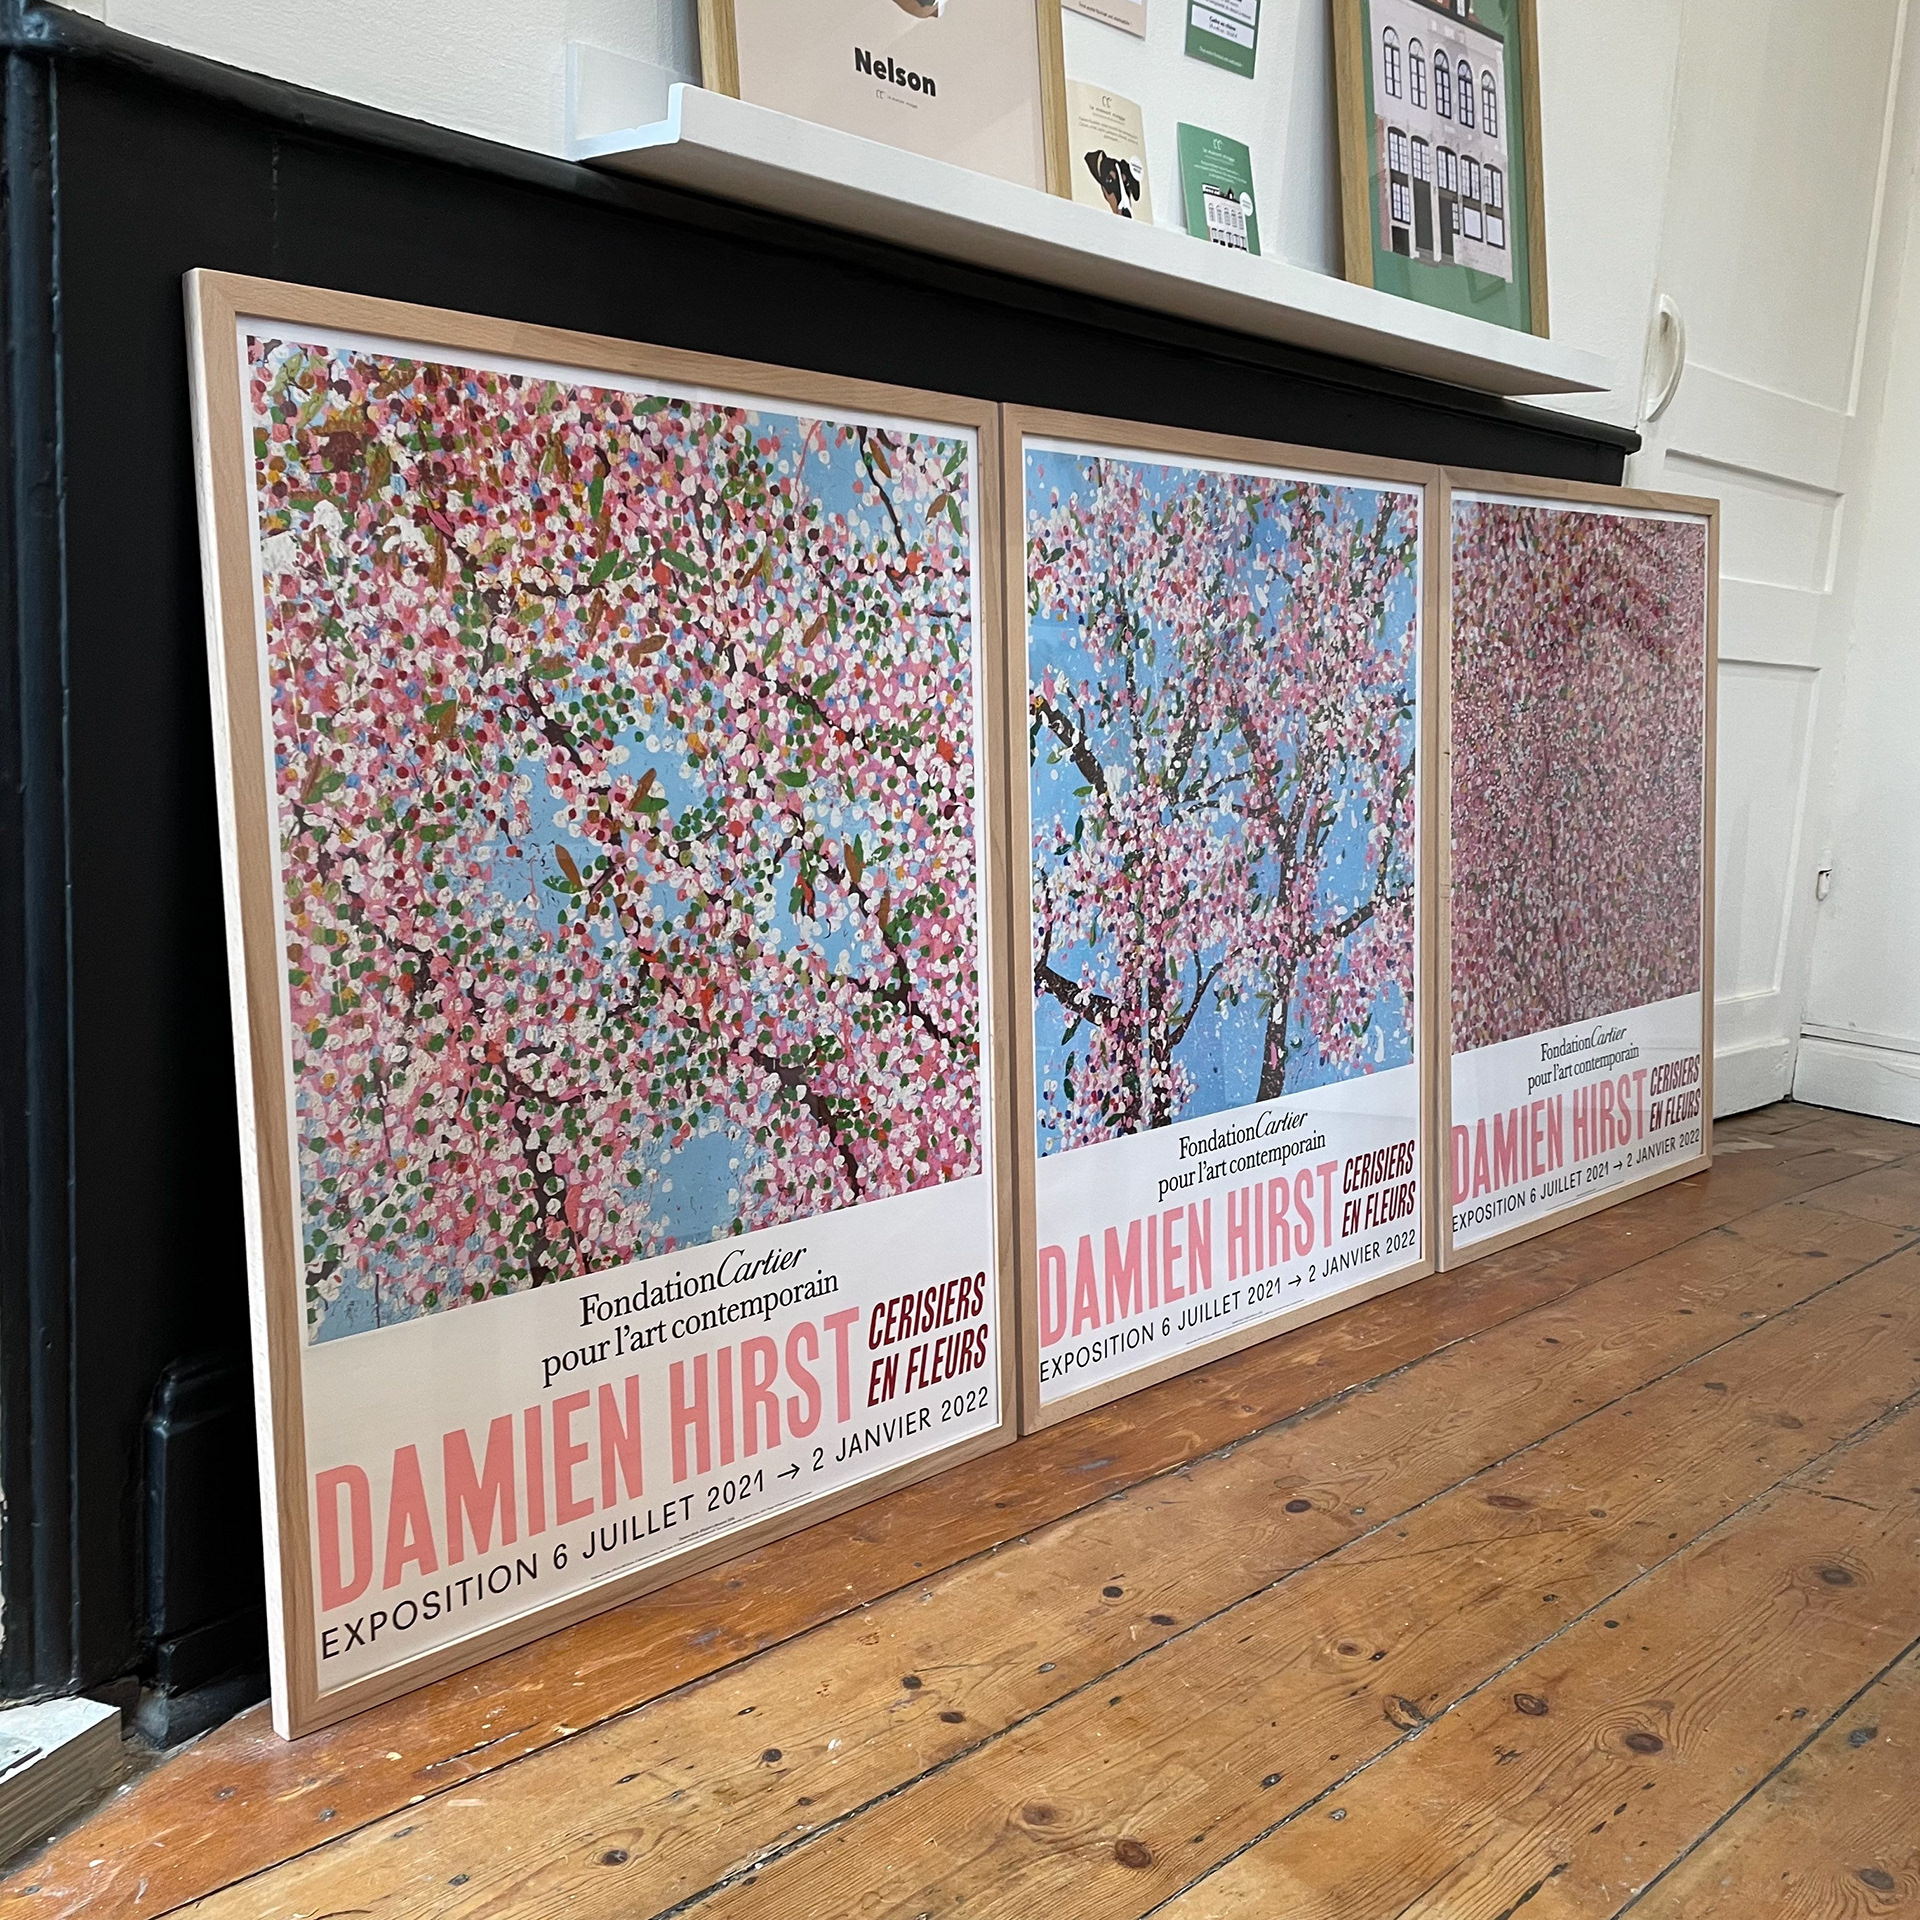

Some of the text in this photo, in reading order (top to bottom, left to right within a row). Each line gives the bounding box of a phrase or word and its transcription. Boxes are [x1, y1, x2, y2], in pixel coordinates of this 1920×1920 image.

[854, 46, 936, 97] Nelson
[1527, 1070, 1552, 1095] pour
[1574, 1042, 1639, 1076] contemporain
[1650, 1054, 1700, 1096] CERISIERS
[1452, 1068, 1647, 1206] DAMIEN HIRST
[1650, 1088, 1701, 1132] EN FLEURS
[1158, 1168, 1195, 1202] pour
[1229, 1130, 1326, 1172] contemporain
[1342, 1139, 1415, 1194] CERISIERS
[1452, 1191, 1526, 1233] EXPOSITION
[1530, 1187, 1536, 1203] 6
[1540, 1170, 1582, 1200] JUILLET
[1586, 1161, 1609, 1183] 2021
[1626, 1152, 1632, 1168] 2
[1636, 1137, 1676, 1164] JANVIER
[1679, 1128, 1700, 1147] 2022
[1341, 1181, 1416, 1238] EN FLEURS
[1038, 1160, 1338, 1348] DAMIEN HIRST
[541, 1338, 610, 1389] pour
[671, 1269, 839, 1339] contemporain
[867, 1271, 986, 1350] CERISIERS
[1039, 1321, 1155, 1382] EXPOSITION
[1161, 1317, 1170, 1337] 6
[1177, 1290, 1241, 1331] JUILLET
[1248, 1276, 1281, 1305] 2021
[1308, 1264, 1316, 1282] 2
[1322, 1241, 1380, 1278] JANVIER
[1386, 1229, 1416, 1254] 2022
[867, 1323, 988, 1408] EN FLEURS
[315, 1374, 644, 1612] DAMIEN
[669, 1306, 860, 1484] HIRST
[321, 1552, 538, 1660] EXPOSITION
[553, 1543, 568, 1570] 6
[582, 1493, 694, 1559] JUILLET
[707, 1469, 763, 1512] 2021
[812, 1447, 824, 1472] 2
[836, 1407, 931, 1461] JANVIER
[941, 1386, 988, 1422] 2022
